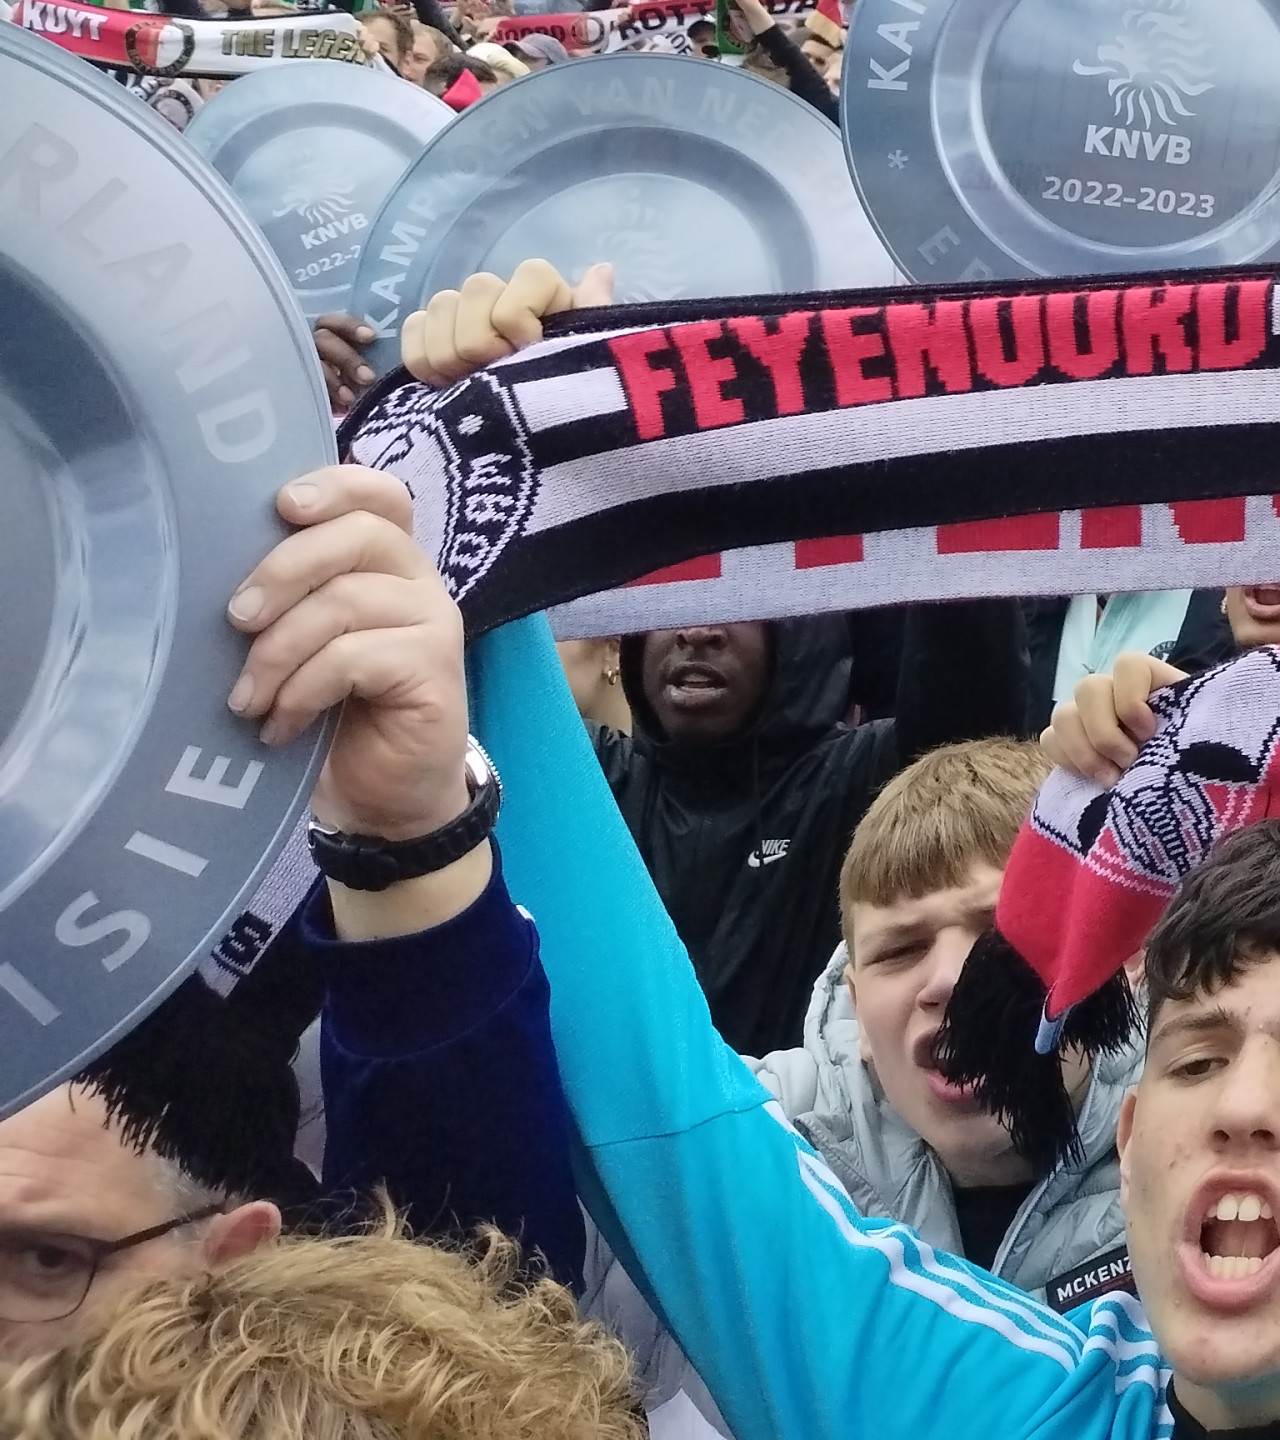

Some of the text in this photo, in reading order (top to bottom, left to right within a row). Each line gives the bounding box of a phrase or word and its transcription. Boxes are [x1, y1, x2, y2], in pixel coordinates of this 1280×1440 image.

[220, 28, 276, 58] THE
[1084, 123, 1193, 167] KNVB
[1041, 175, 1216, 220] 2022-2023
[300, 212, 369, 250] KNVB
[607, 279, 1273, 442] FEYENOORD
[758, 838, 792, 857] NIKE
